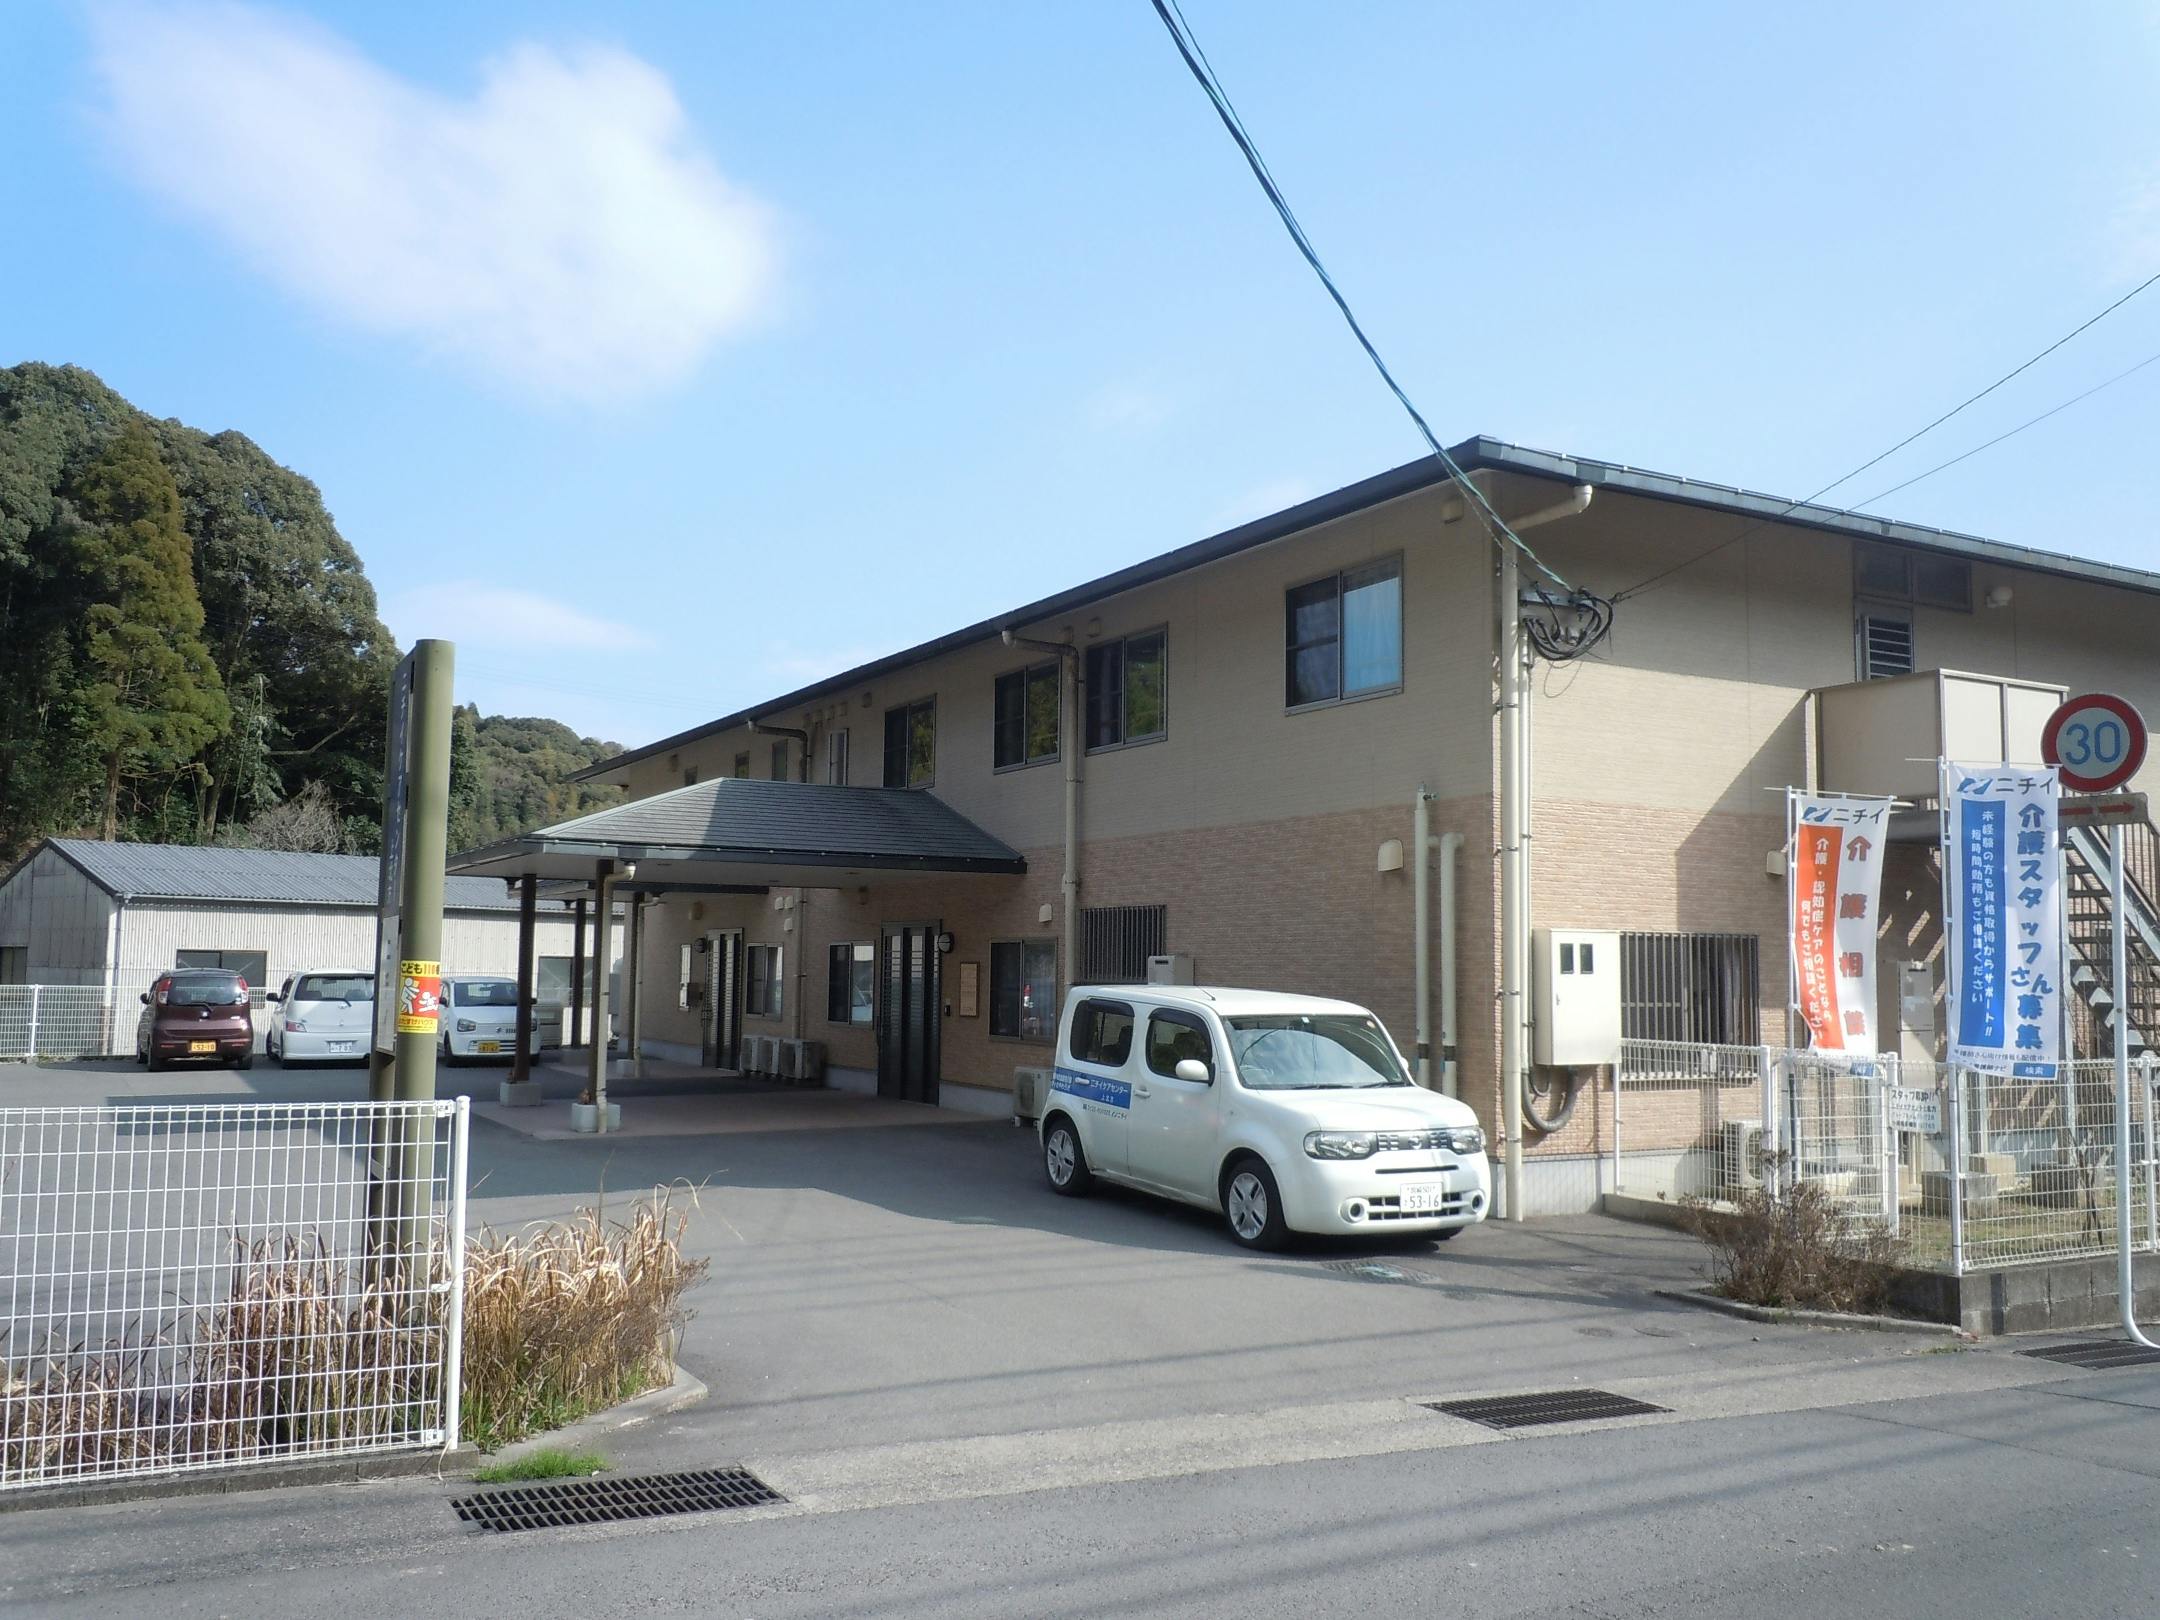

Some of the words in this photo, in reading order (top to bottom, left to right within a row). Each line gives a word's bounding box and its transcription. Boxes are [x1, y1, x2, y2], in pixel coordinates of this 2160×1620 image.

[2065, 721, 2121, 765] 30
[1996, 777, 2054, 795] ニチイ
[1833, 808, 1885, 824] ニチイ
[2011, 803, 2053, 1049] 介護スタッフさん募集
[1410, 1194, 1439, 1209] 53-16
